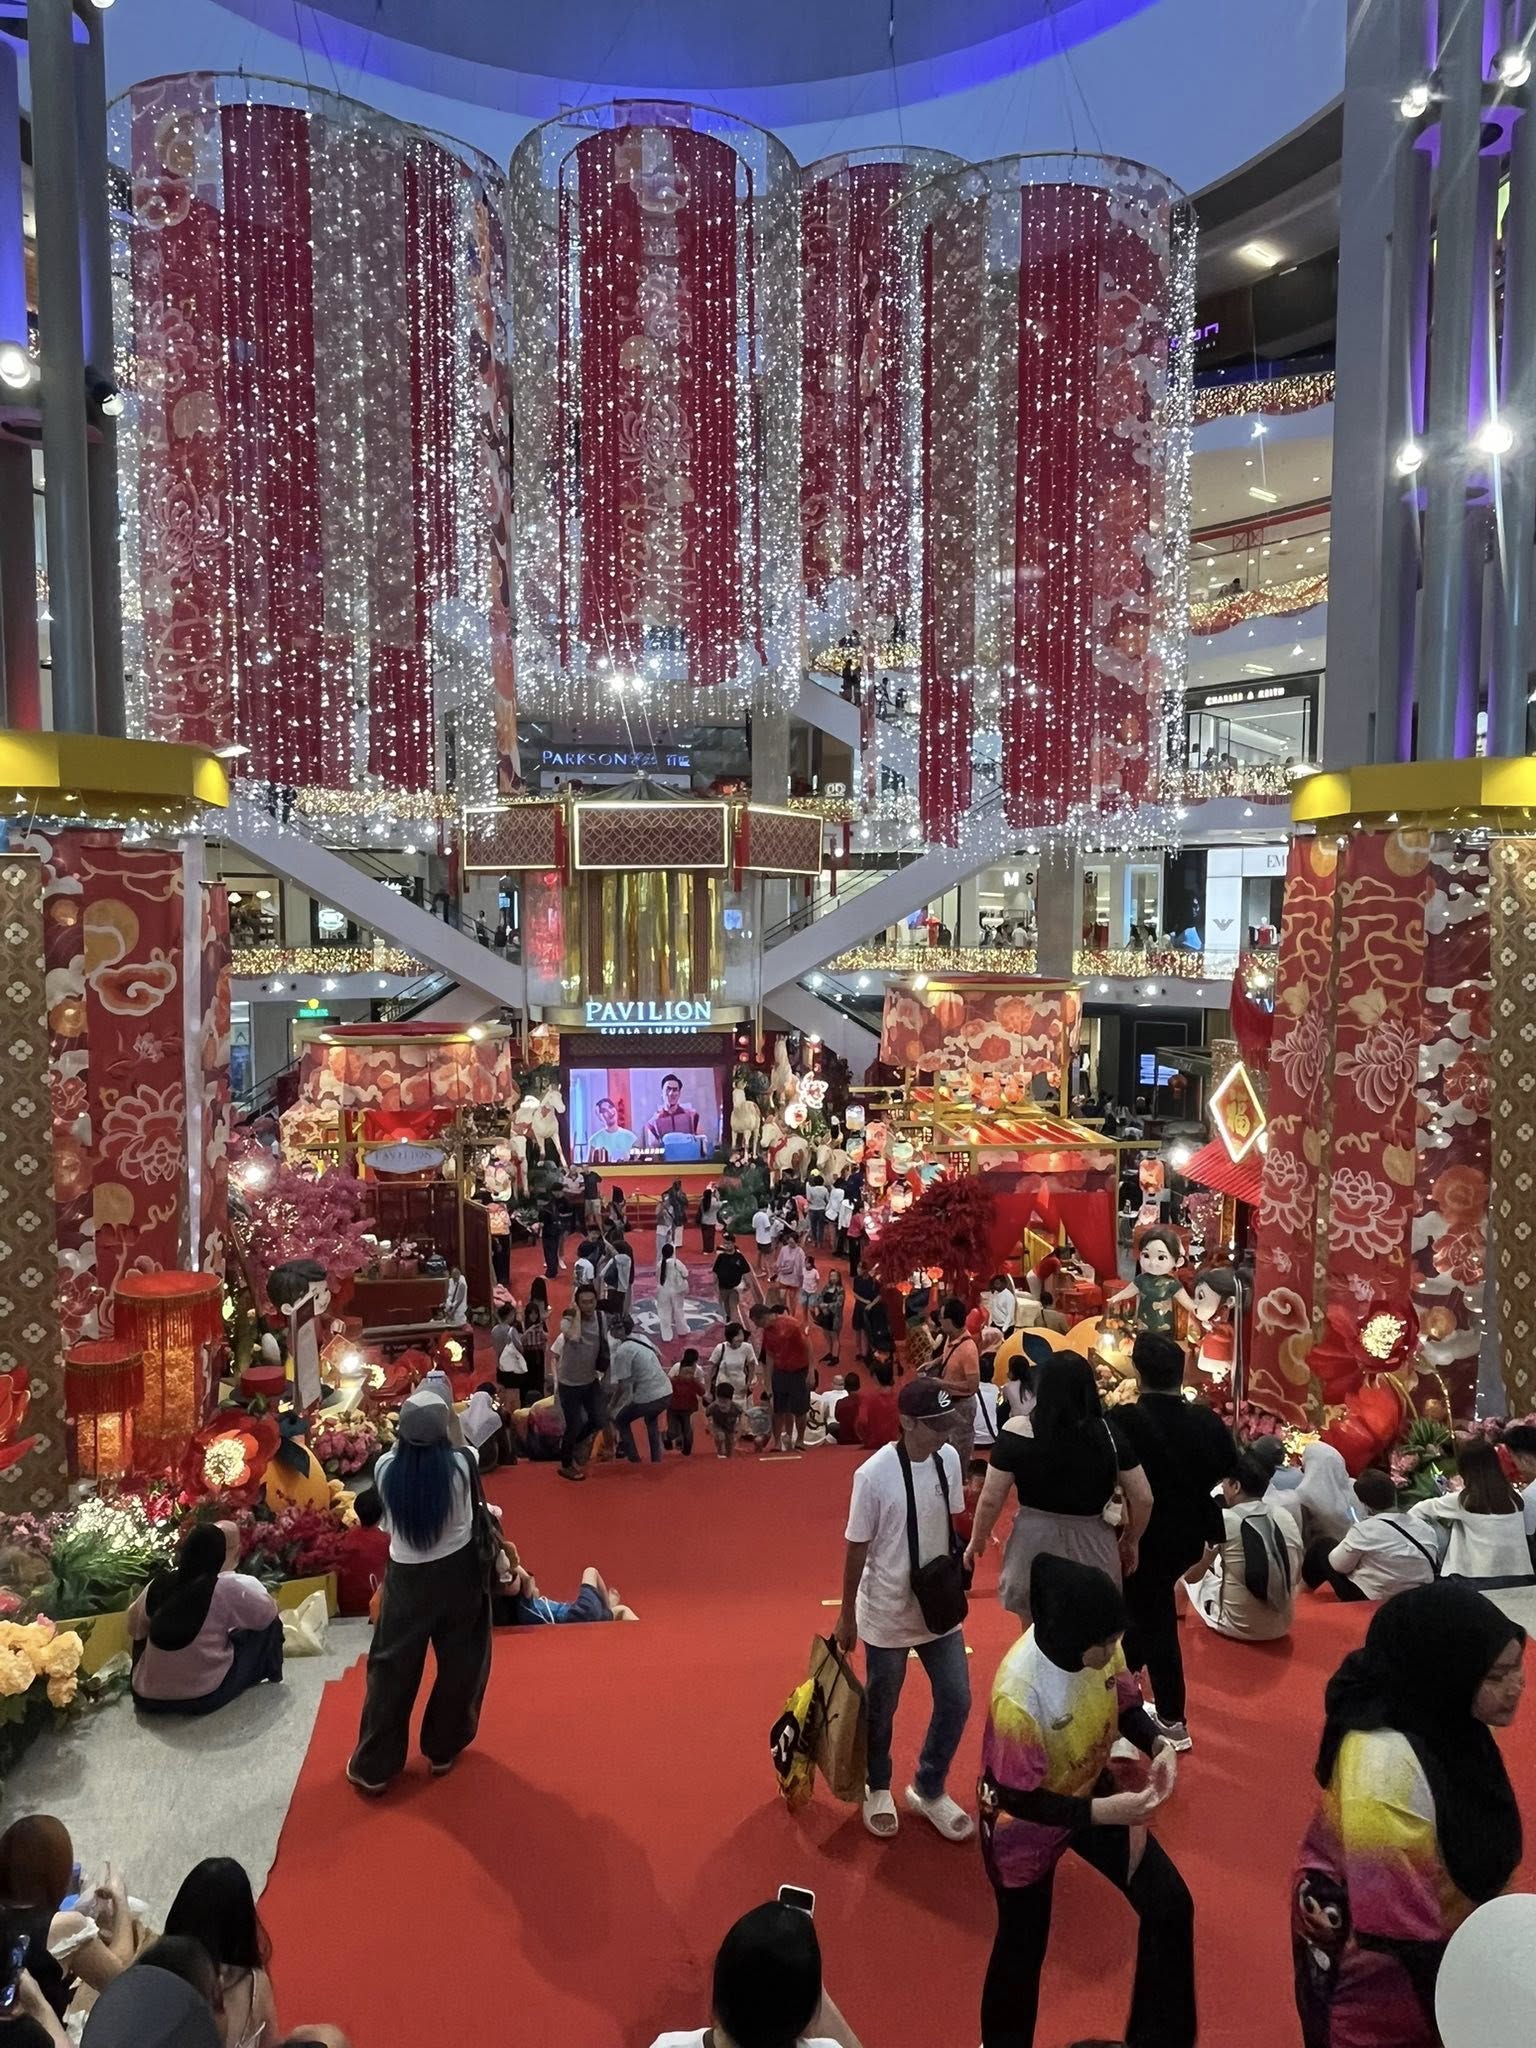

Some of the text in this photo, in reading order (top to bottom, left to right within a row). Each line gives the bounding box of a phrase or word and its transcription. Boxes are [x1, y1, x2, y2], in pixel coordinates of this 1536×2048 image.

[542, 751, 627, 766] PARKSON
[585, 1001, 711, 1021] PAVILION
[600, 1027, 640, 1035] KUALA
